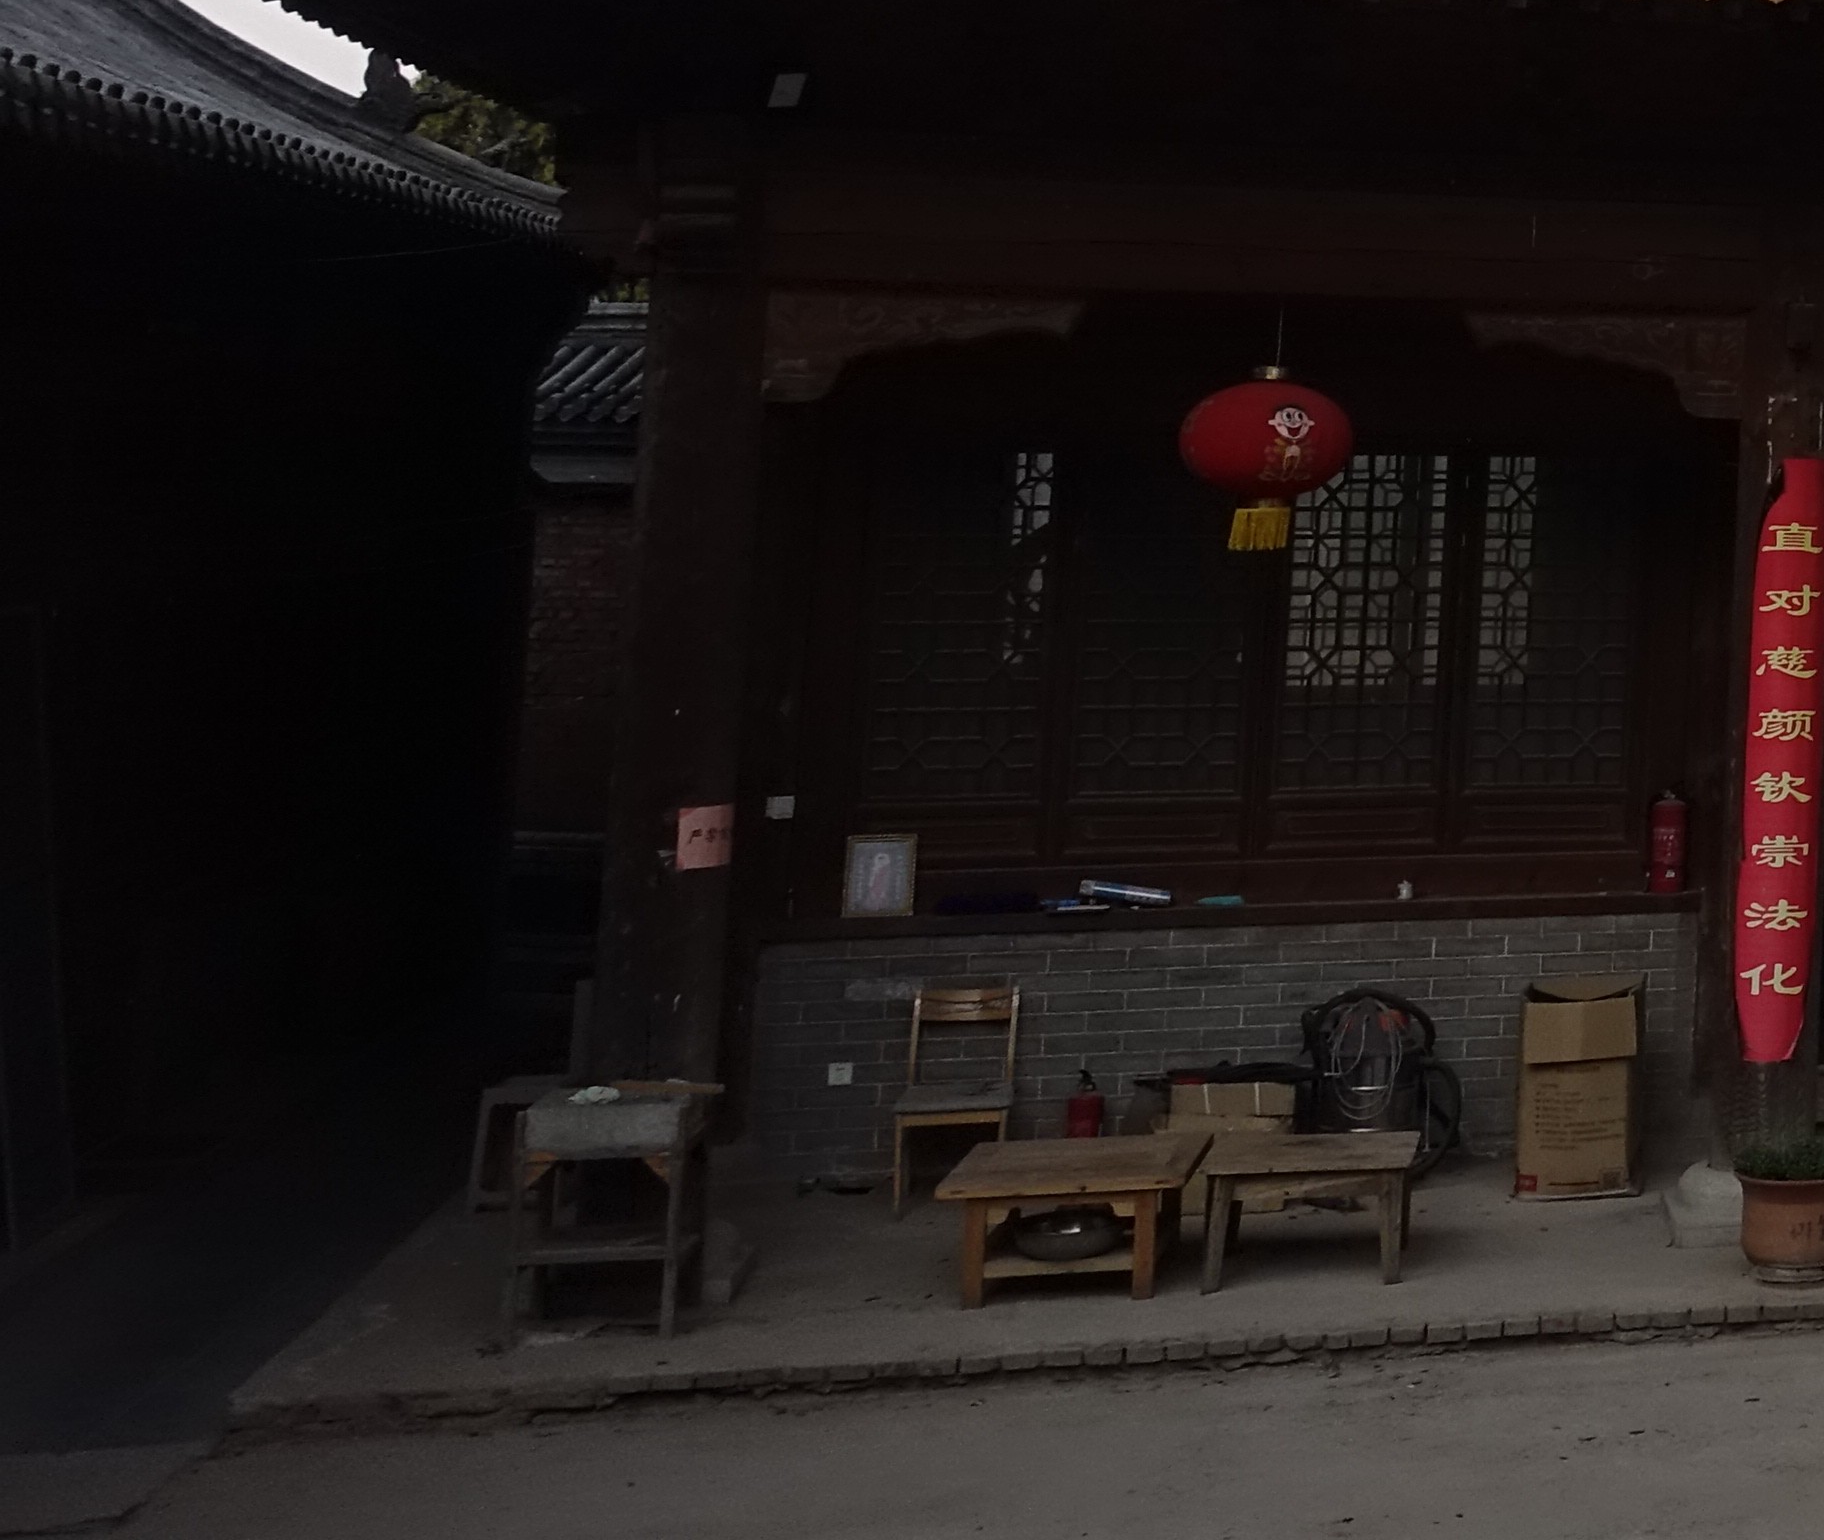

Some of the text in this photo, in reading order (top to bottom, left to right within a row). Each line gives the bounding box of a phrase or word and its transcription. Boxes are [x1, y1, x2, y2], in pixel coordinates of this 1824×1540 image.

[1739, 521, 1823, 997] 直对慈颜钦崇法化
